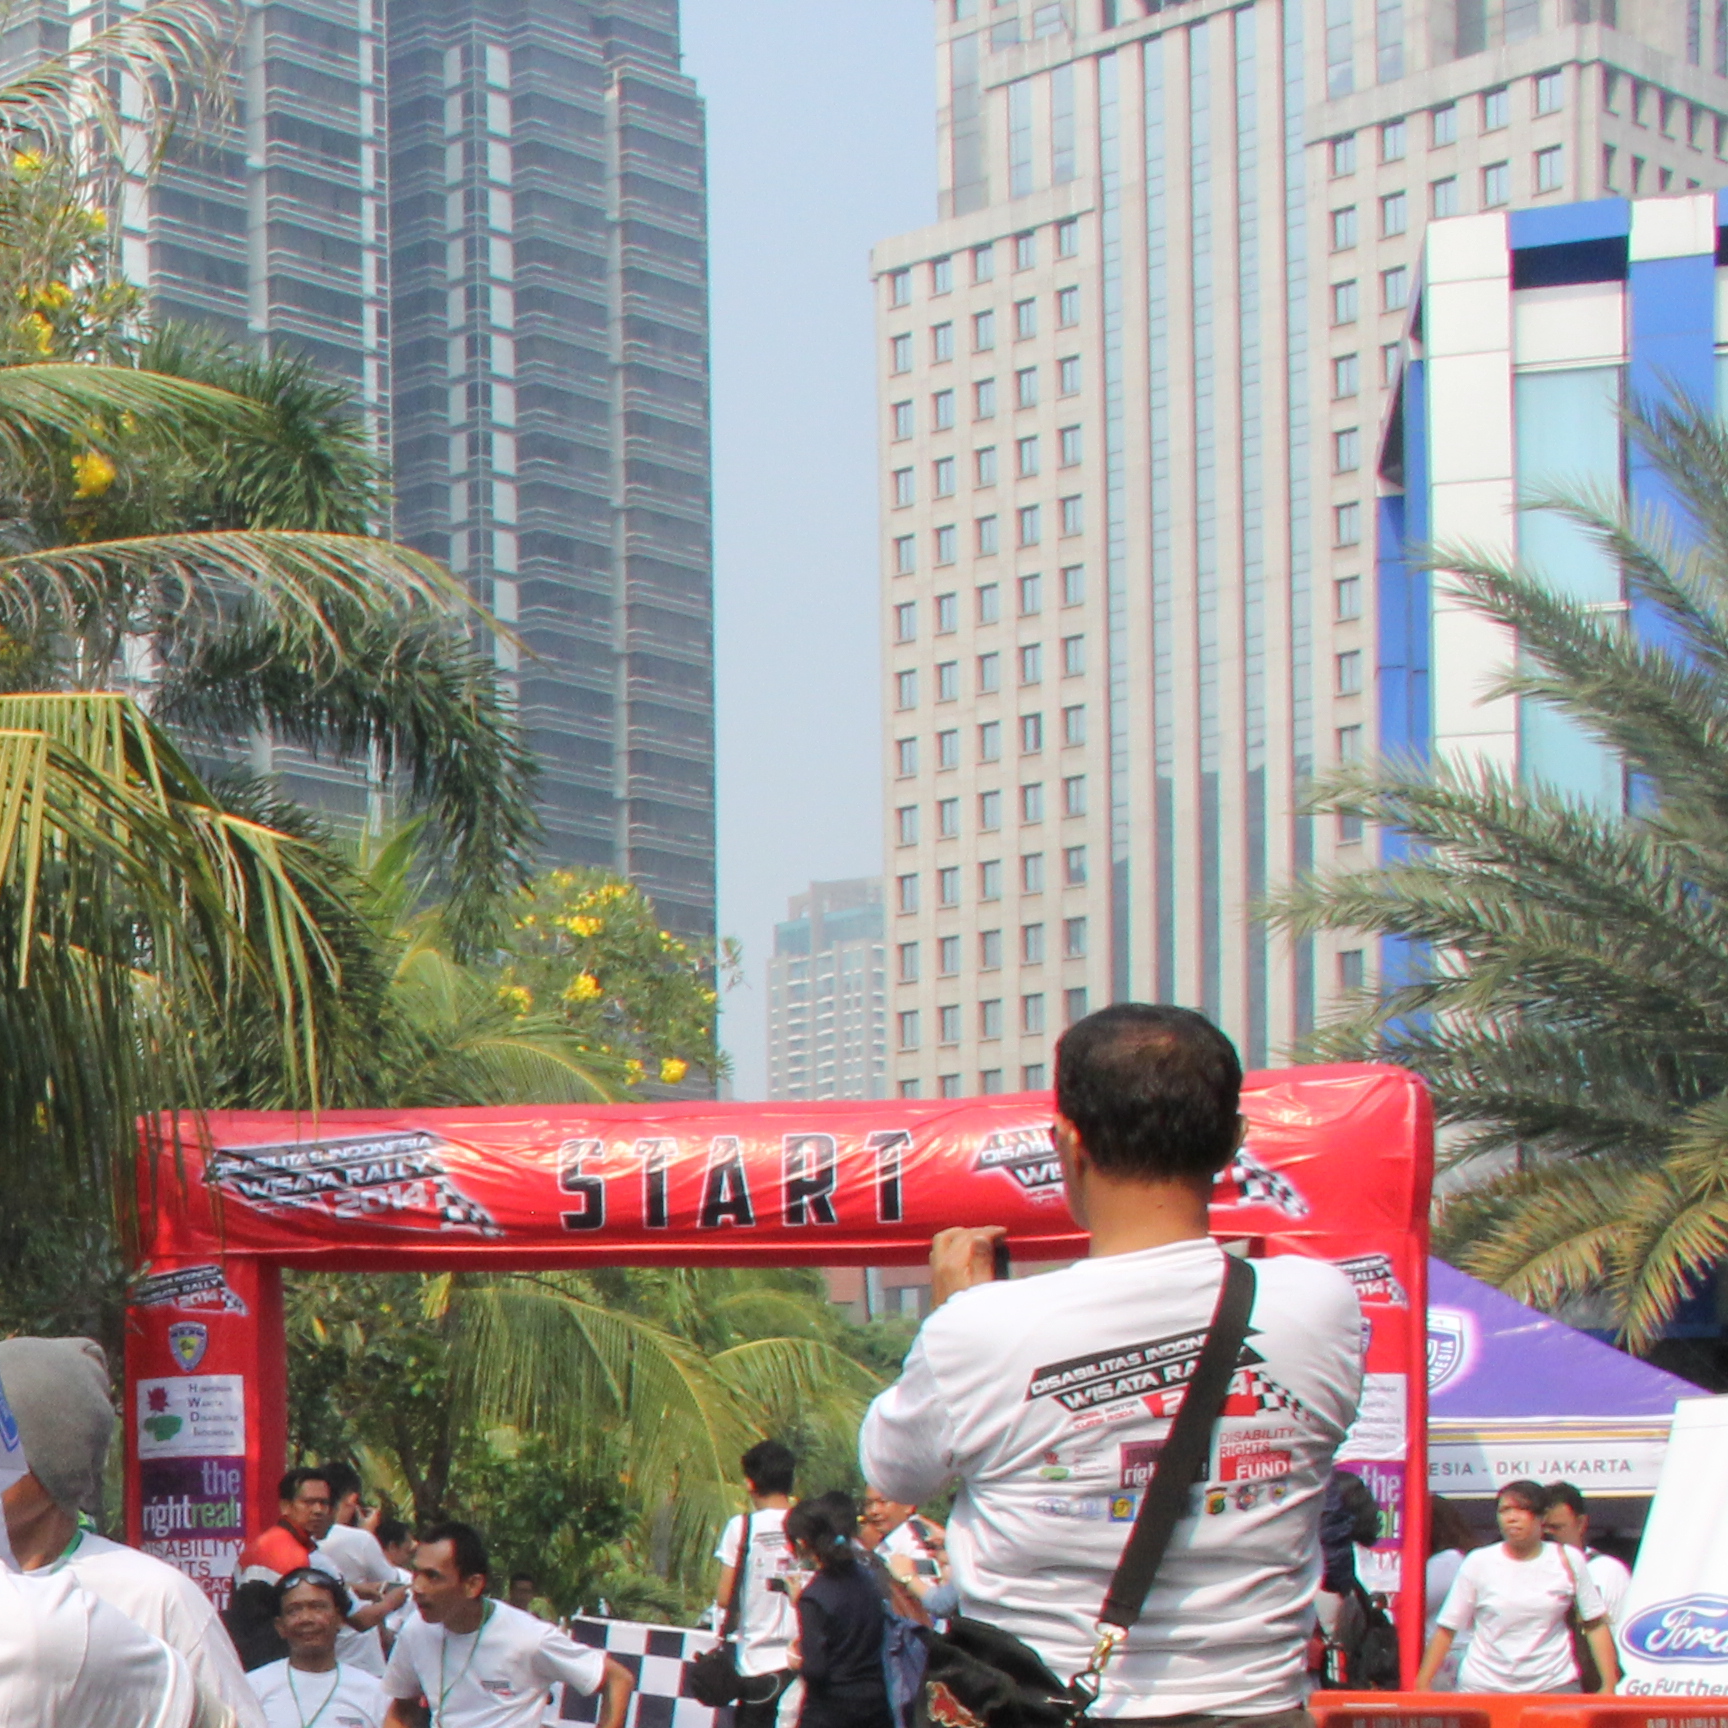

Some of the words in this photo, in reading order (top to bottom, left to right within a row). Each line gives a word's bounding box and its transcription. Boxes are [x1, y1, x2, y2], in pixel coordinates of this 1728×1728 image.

[327, 1135, 433, 1162] INDONESIA
[239, 1169, 339, 1198] WISATA
[346, 1154, 432, 1184] RALLY
[558, 1130, 914, 1231] START
[333, 1181, 430, 1219] 2014
[1031, 1352, 1142, 1395] DISABILITAS
[1144, 1333, 1209, 1362] INDON
[1062, 1375, 1160, 1411] WISATA
[1220, 1427, 1296, 1444] DISABILITY
[1220, 1442, 1271, 1458] RIGHTS
[202, 1460, 242, 1496] the
[1237, 1460, 1288, 1481] FUND
[1497, 1460, 1530, 1476] DKI
[1538, 1458, 1633, 1475] JAKARTA
